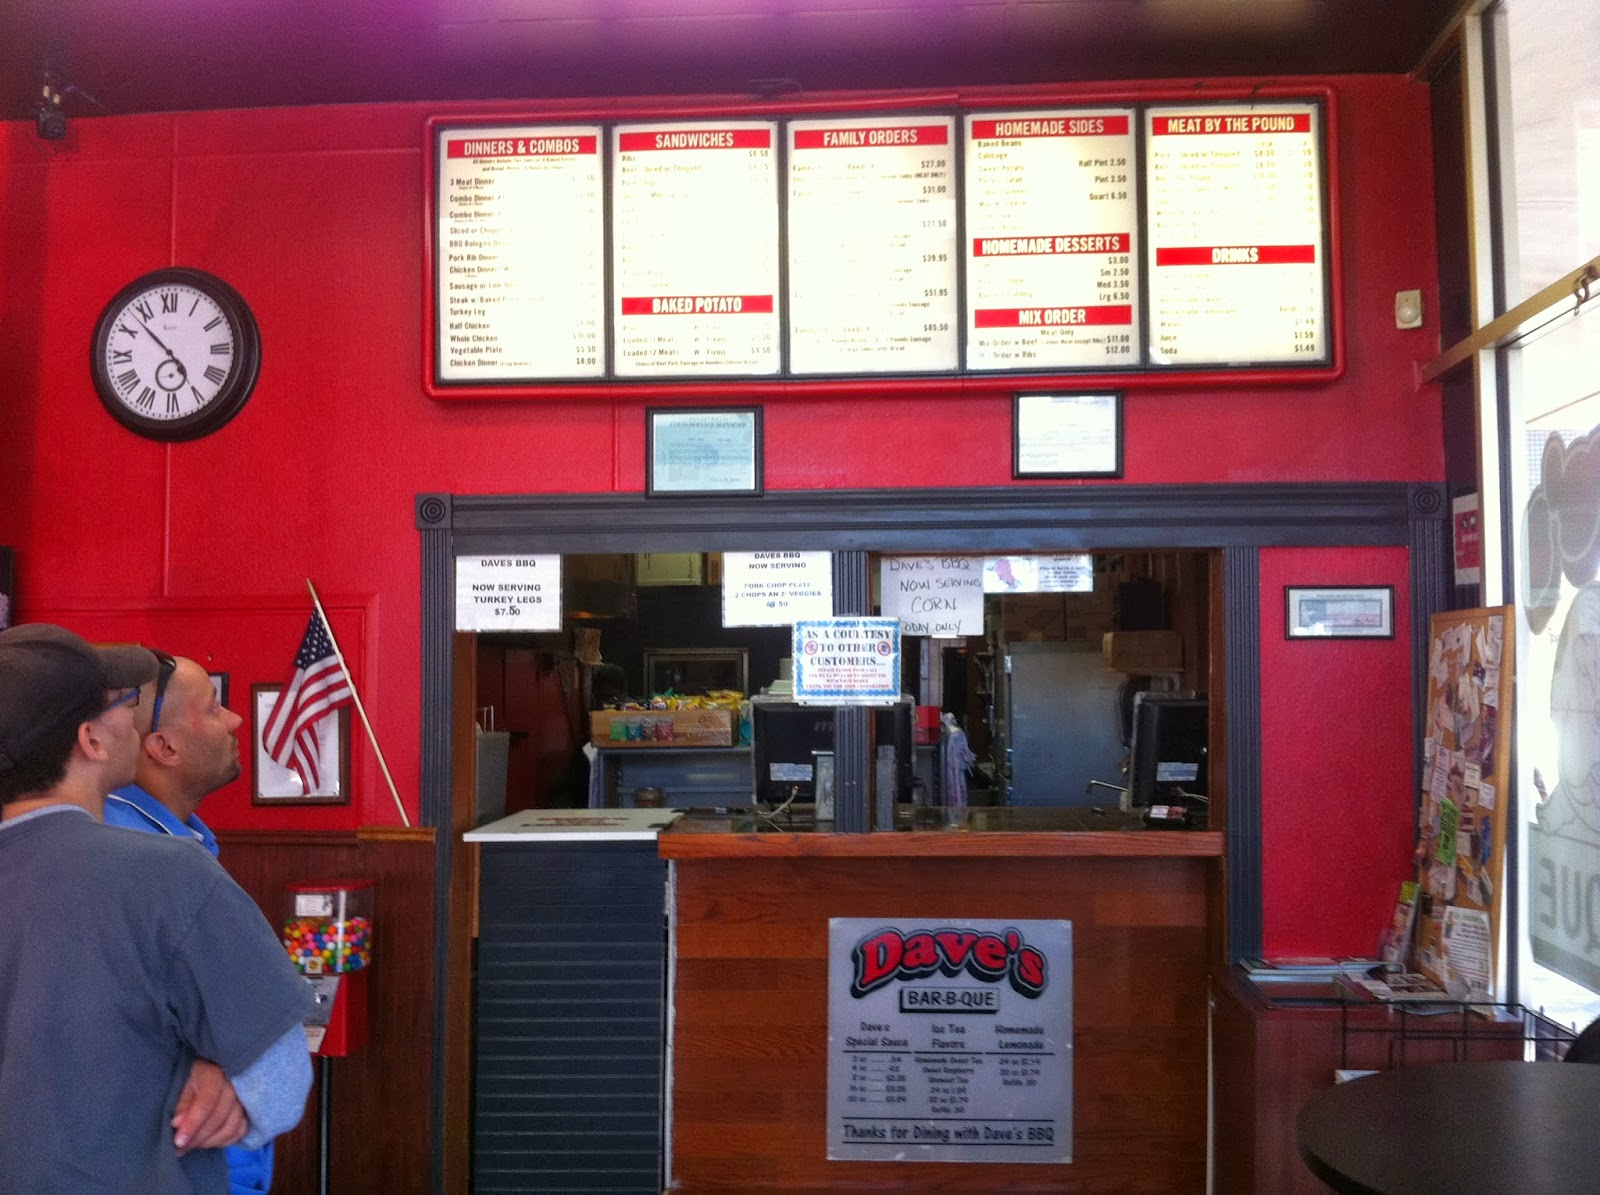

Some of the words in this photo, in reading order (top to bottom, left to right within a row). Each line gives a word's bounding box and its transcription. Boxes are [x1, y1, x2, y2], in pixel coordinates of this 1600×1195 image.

[995, 121, 1066, 137] HOMEMADE
[1068, 119, 1105, 134] SIDES
[1167, 119, 1203, 133] MEAT
[1205, 118, 1222, 132] BY
[1225, 117, 1249, 132] THE
[1252, 116, 1295, 131] POUND
[655, 132, 734, 148] SANDWICHES
[823, 131, 866, 147] FAMILY
[868, 129, 918, 145] ORDERS
[464, 141, 514, 156] DINNERS
[517, 141, 526, 154] &
[529, 139, 580, 153] COMBOS
[921, 160, 946, 169] $27.00
[1079, 159, 1093, 167] Half
[1094, 159, 1108, 167] Pint
[456, 178, 473, 186] Meat
[474, 178, 495, 186] Dinner
[1094, 176, 1109, 184] Pint
[1089, 193, 1109, 201] Quart
[922, 219, 947, 227] $2750
[464, 241, 491, 249] Bologna
[982, 238, 1053, 255] HOMEMADE
[1055, 236, 1120, 253] DESSERTS
[449, 254, 465, 262] Pork
[479, 253, 499, 261] Dinner
[1211, 247, 1259, 263] DRINKS
[449, 266, 476, 274] Chicken
[1113, 268, 1129, 276] 2.50
[449, 283, 478, 291] Sausage
[1099, 293, 1111, 302] Lrg
[652, 298, 693, 313] BAKED
[695, 296, 742, 313] POTATO
[450, 308, 472, 317] Turkey
[473, 308, 486, 316] Leg
[1018, 310, 1042, 325] MIX
[1044, 308, 1086, 325] ORDER
[449, 322, 463, 330] Half
[464, 322, 491, 330] Chicken
[1060, 328, 1074, 336] Only
[450, 335, 470, 343] Whole
[1106, 335, 1130, 344] $11.00
[450, 347, 484, 356] Vegetable
[485, 346, 503, 354] Plate
[1106, 346, 1130, 354] $12.00
[1160, 347, 1178, 355] Soda
[450, 359, 476, 367] Chicken
[477, 359, 498, 367] Dinner
[941, 557, 970, 571] BBQ
[900, 579, 931, 592] NOW
[935, 577, 982, 589] SERVING
[474, 596, 514, 604] TURKEY
[517, 596, 542, 604] LEGS
[911, 596, 957, 614] CORN
[901, 620, 930, 634] ODAY
[935, 620, 961, 633] ONLY
[806, 629, 819, 639] AS
[824, 629, 830, 639] A
[820, 643, 834, 653] TO
[838, 643, 877, 653] OTHER
[854, 928, 1046, 997] Dave's
[908, 991, 994, 1007] BAR-B-QUE
[948, 1023, 966, 1034] Tea
[995, 1024, 1045, 1035] Homemade
[845, 1036, 879, 1048] Special
[880, 1037, 909, 1047] Sauce
[999, 1039, 1044, 1050] Lemonade
[843, 1124, 887, 1139] Thanks
[890, 1125, 909, 1139] for
[913, 1124, 951, 1142] Dining
[954, 1126, 980, 1140] with
[983, 1126, 1023, 1140] Dave's
[1027, 1126, 1055, 1142] BBQ
